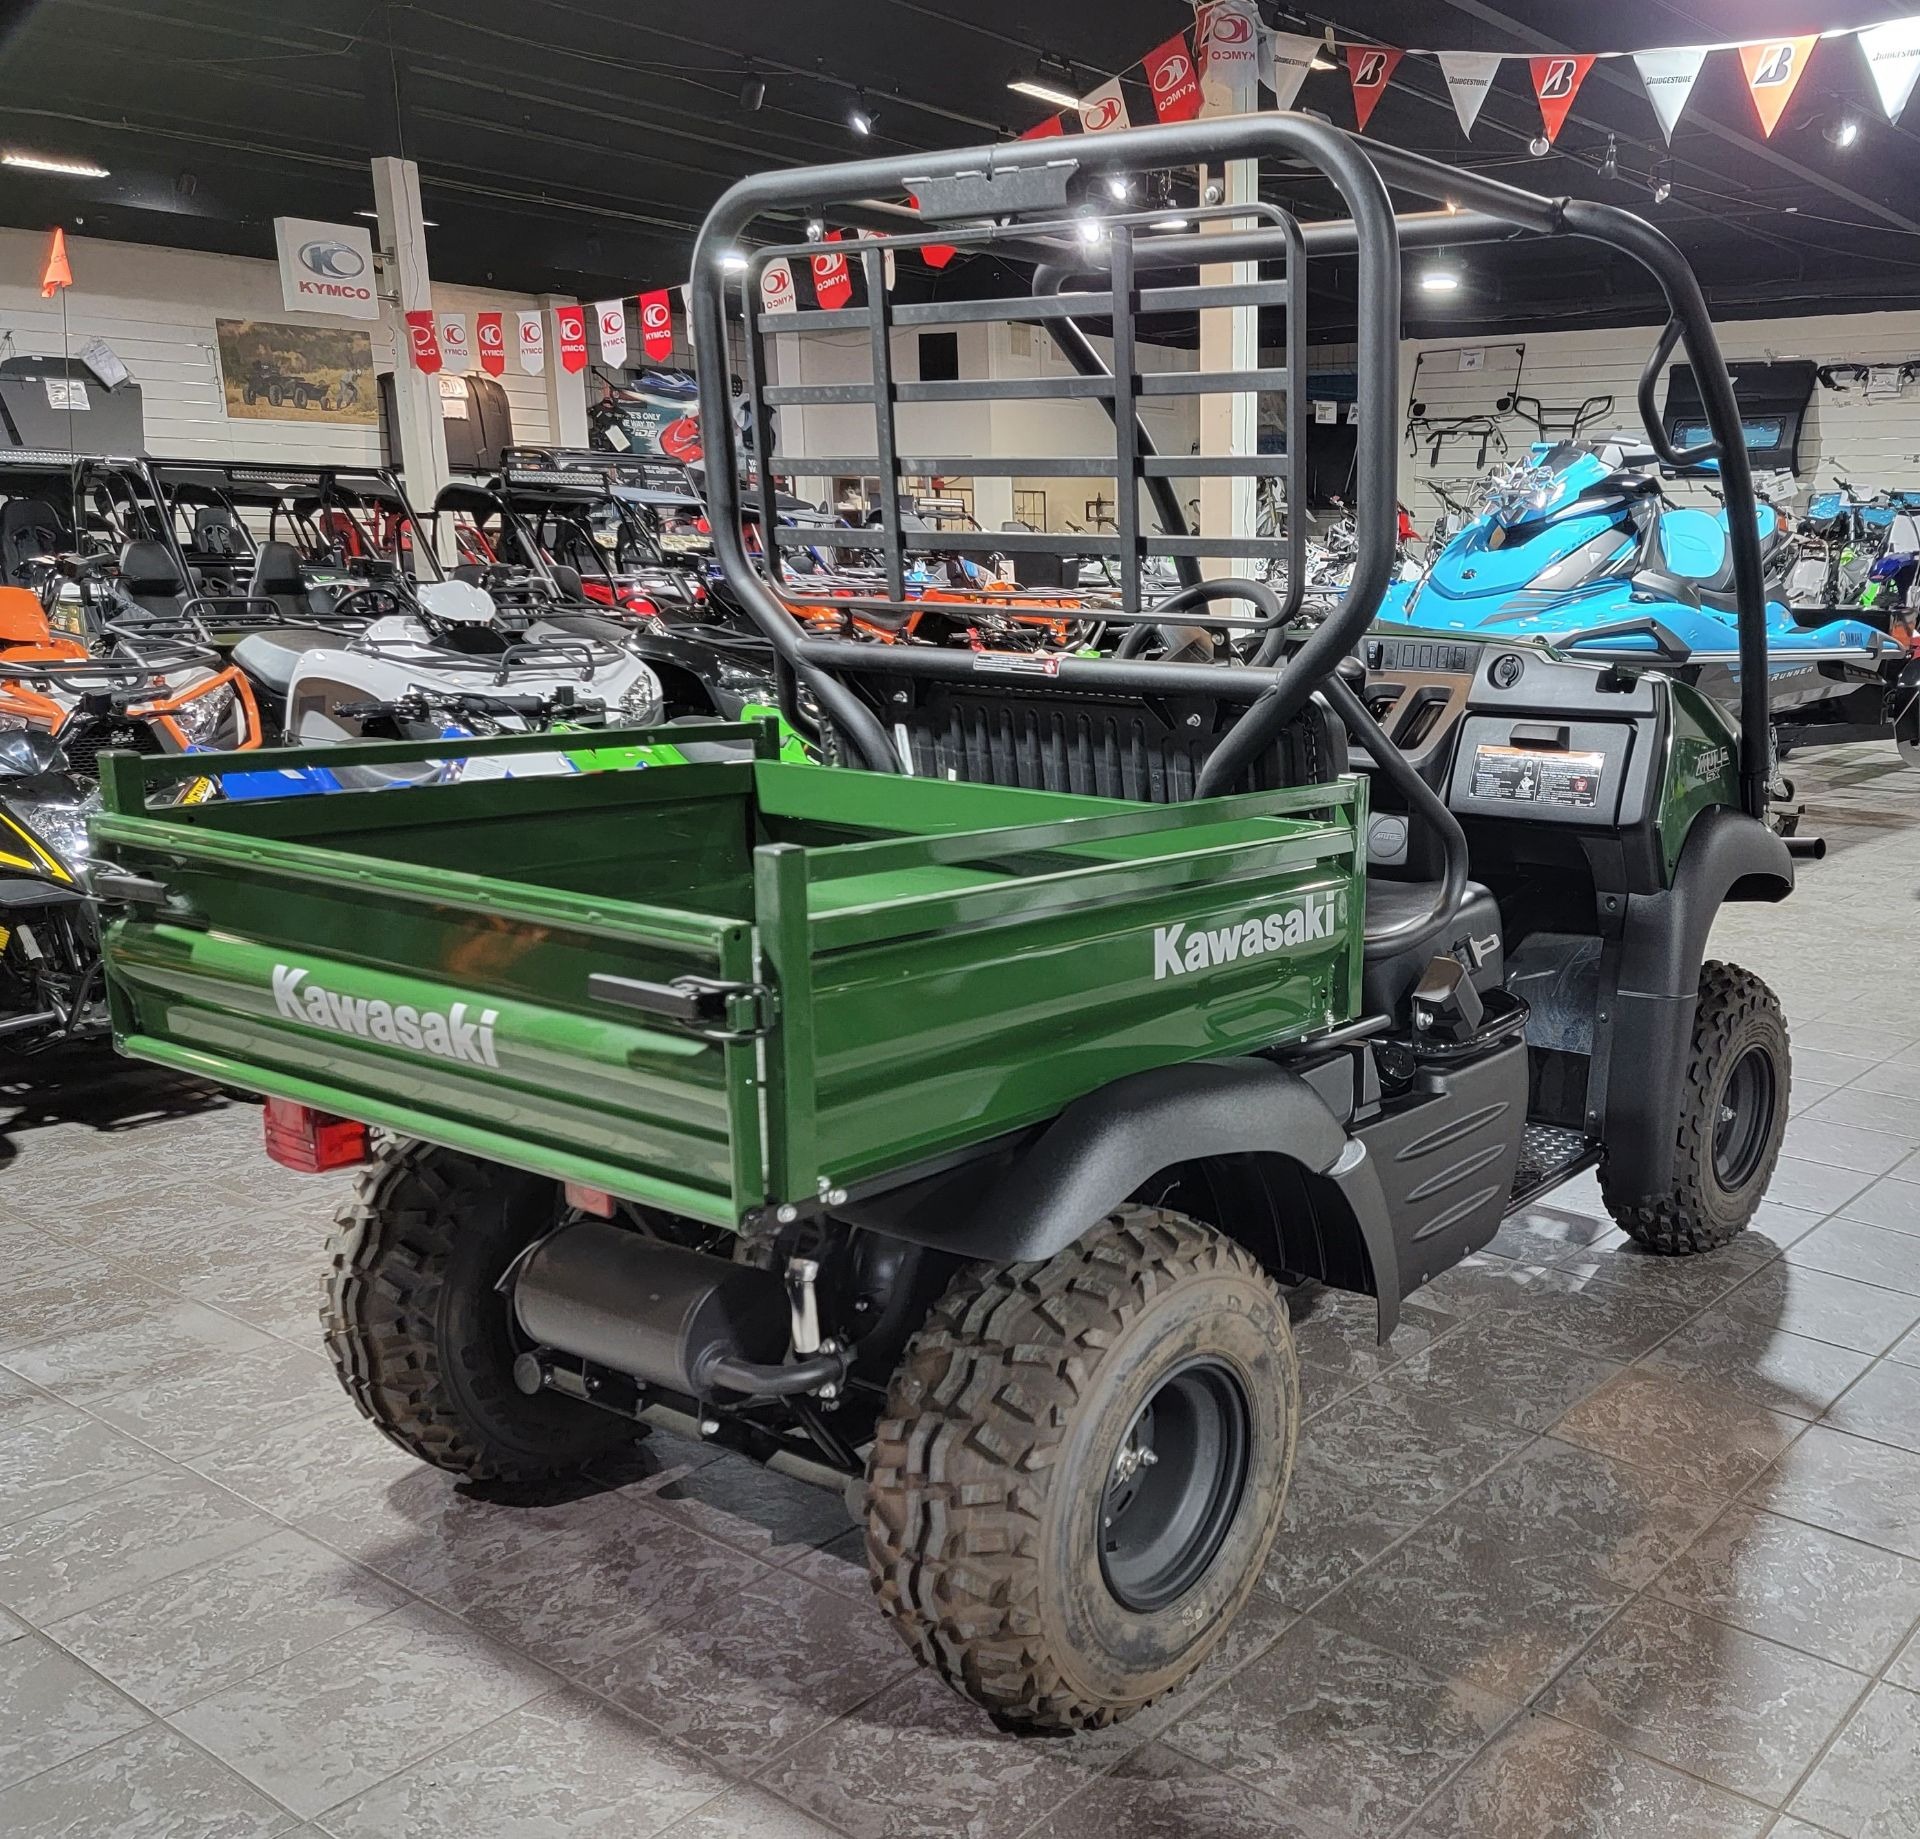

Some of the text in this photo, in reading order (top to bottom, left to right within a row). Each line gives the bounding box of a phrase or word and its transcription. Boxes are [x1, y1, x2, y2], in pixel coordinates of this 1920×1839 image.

[1448, 76, 1489, 87] BRIDGESTONE
[1646, 75, 1692, 85] BRIDGESTONE
[299, 280, 371, 300] KYMCO
[645, 329, 671, 340] KYMCO
[444, 348, 468, 356] KYMCO
[521, 347, 543, 355] KYMCO
[642, 412, 661, 420] ONLY
[1696, 746, 1731, 777] MULE
[1154, 891, 1335, 981] Kawasaki
[272, 964, 500, 1068] Kawasaki
